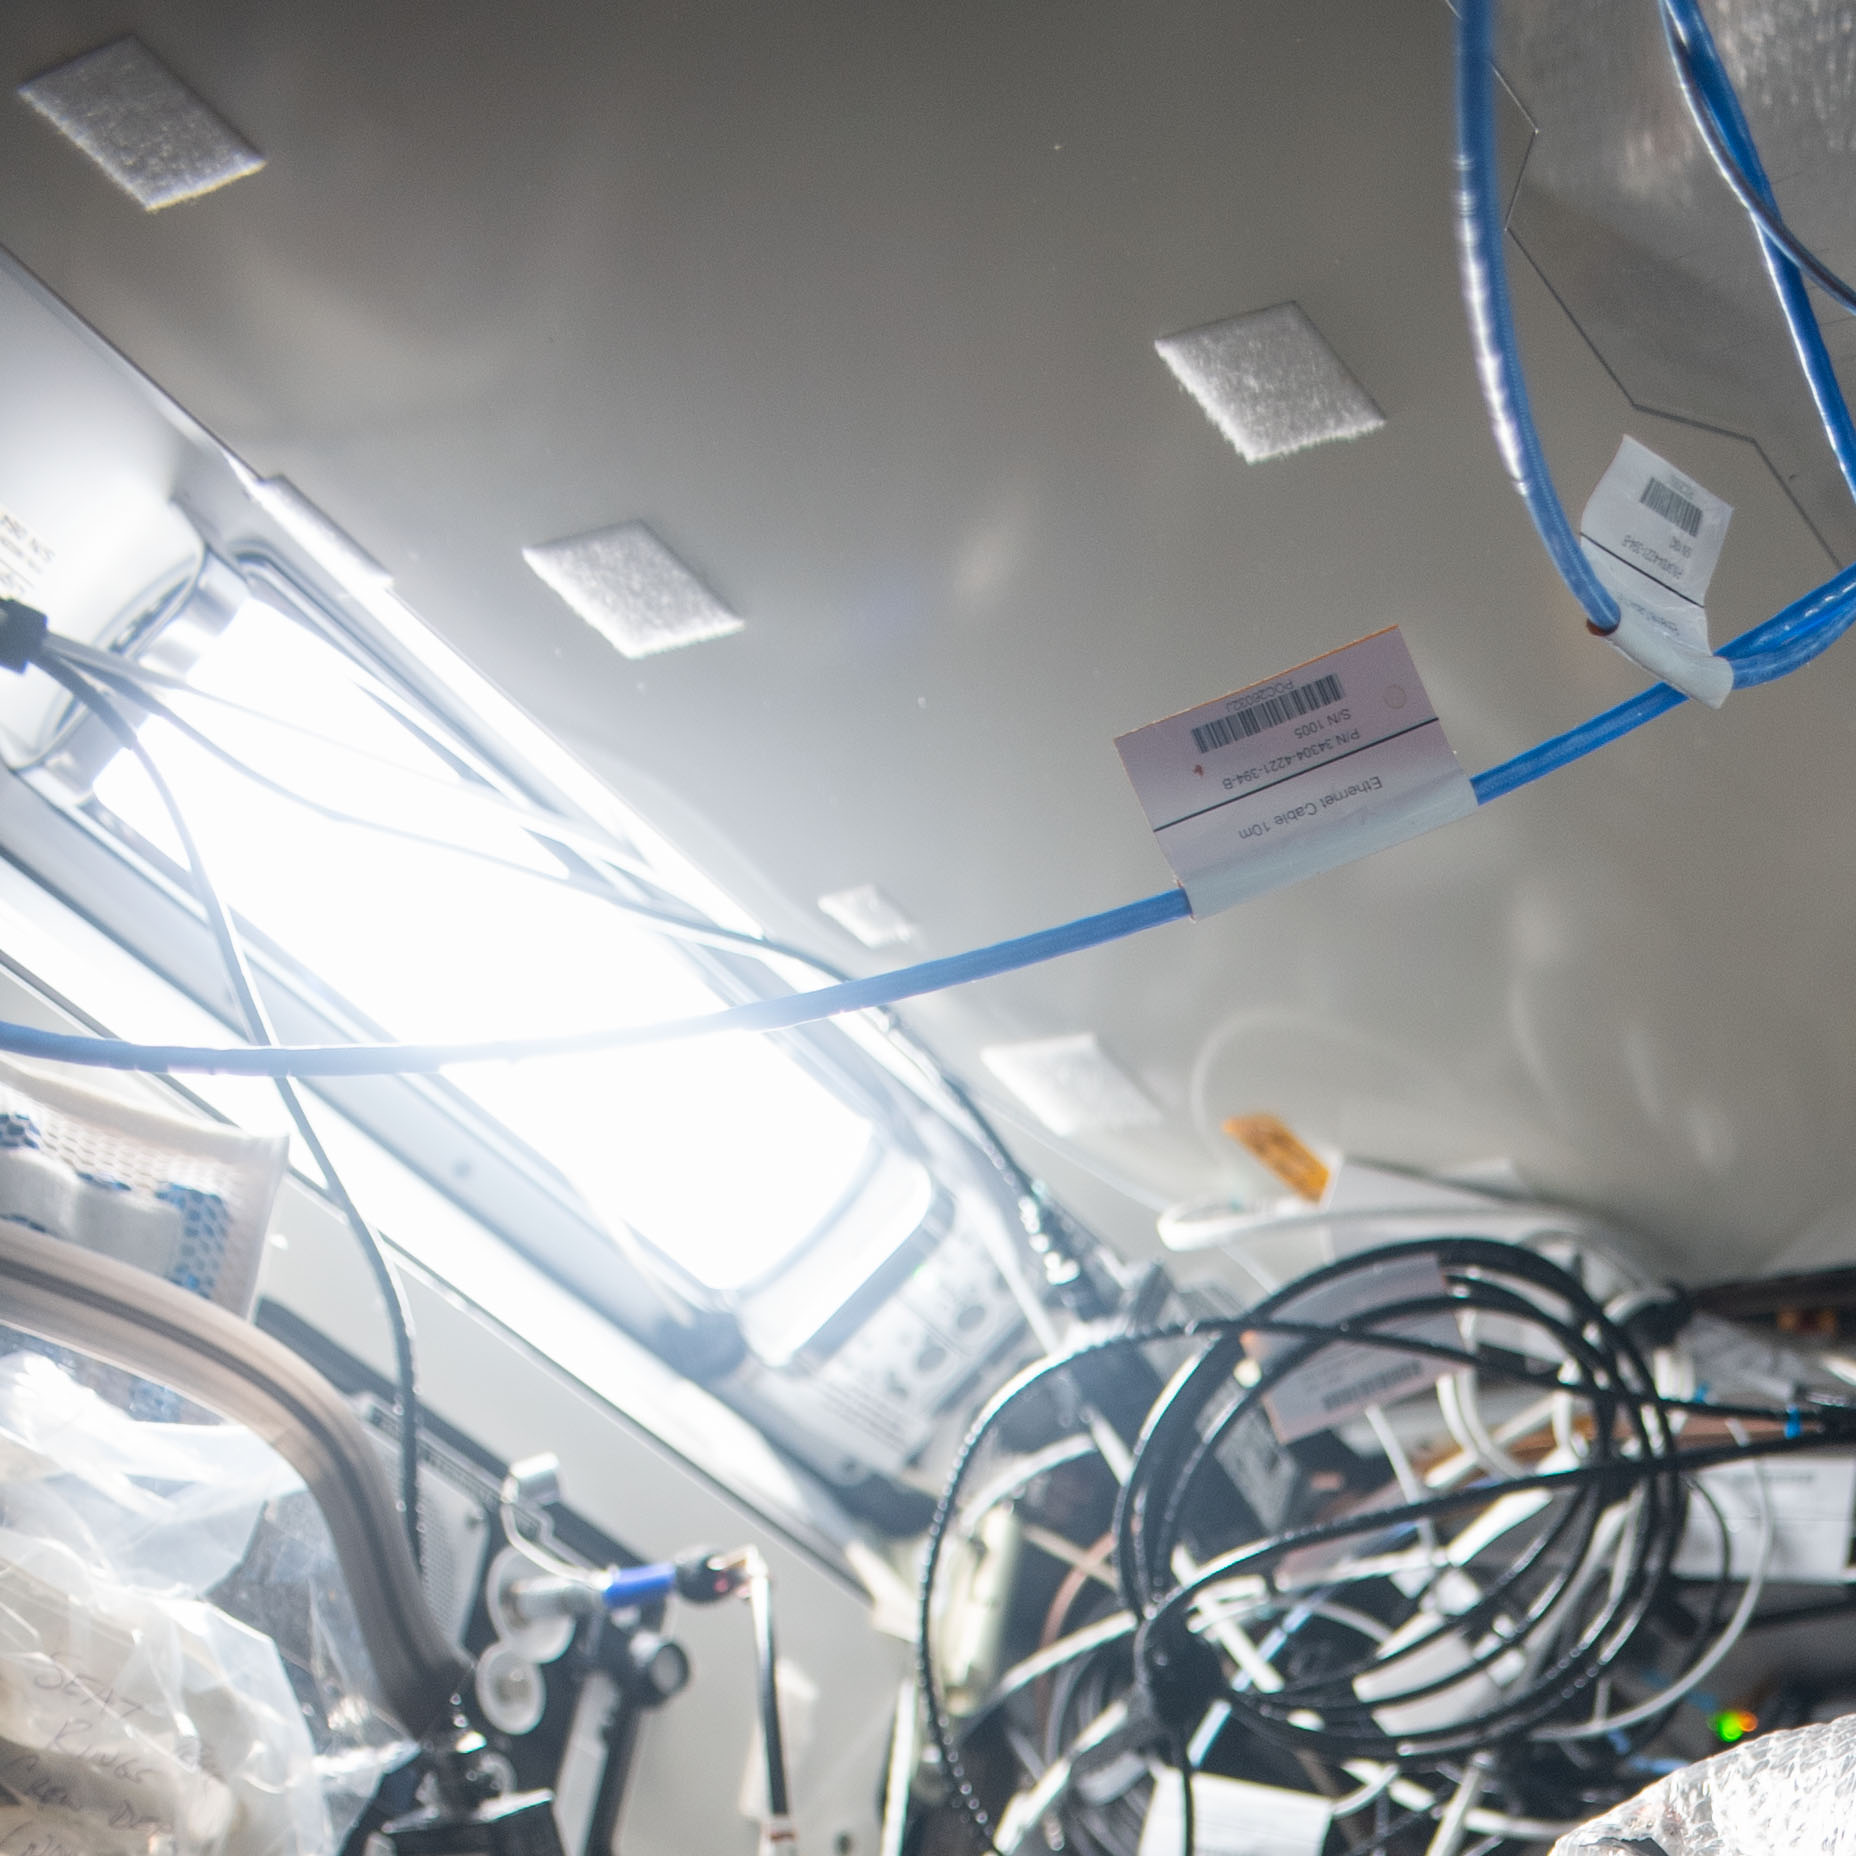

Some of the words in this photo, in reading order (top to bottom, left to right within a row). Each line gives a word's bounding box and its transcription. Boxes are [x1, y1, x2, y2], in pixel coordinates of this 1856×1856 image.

[1325, 706, 1351, 725] S/N
[1292, 718, 1325, 739] 1005
[1331, 726, 1361, 747] P/N
[1219, 737, 1334, 790] 34304-4221-394-B
[1317, 773, 1383, 810] Ethernet
[1272, 800, 1318, 828] Cable
[1237, 818, 1272, 842] 10m
